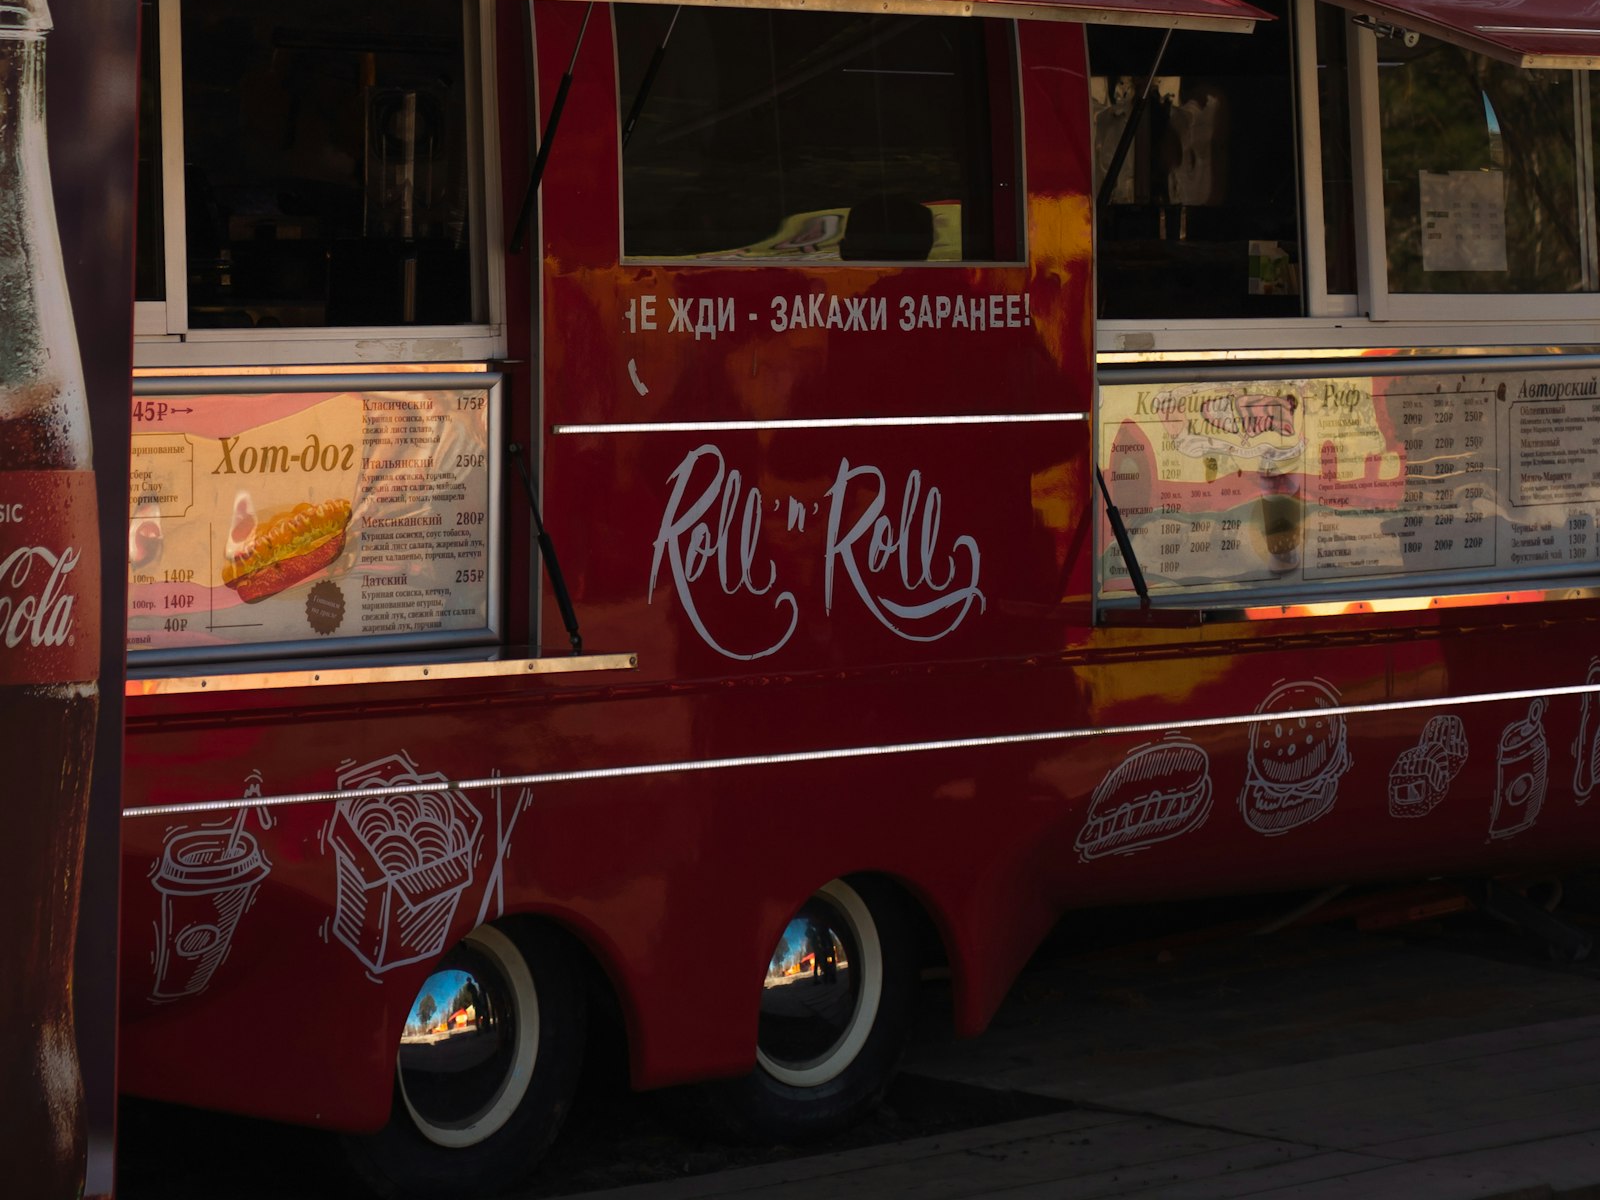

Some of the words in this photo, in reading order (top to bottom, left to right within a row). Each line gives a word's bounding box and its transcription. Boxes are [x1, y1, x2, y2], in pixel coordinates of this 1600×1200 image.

[668, 297, 735, 341] ЖДИ
[770, 293, 888, 333] ЗАКАЖИ
[899, 293, 1031, 332] ЗАРАНЕЕ!
[1518, 376, 1597, 400] Авторский
[1321, 383, 1361, 412] Раф
[1135, 389, 1235, 421] Кофейная
[1187, 413, 1275, 435] классика
[131, 445, 185, 457] аринованые
[211, 433, 354, 475] Хот-дог
[1111, 443, 1144, 454] Эспрессо
[362, 456, 434, 470] Итальянский
[130, 470, 153, 480] сберг
[130, 494, 178, 505] сортименте
[1119, 506, 1153, 517] ерикано
[361, 514, 442, 528] Мексиканский
[648, 444, 798, 660] Roll
[823, 457, 987, 642] Roll
[361, 574, 407, 588] Датский
